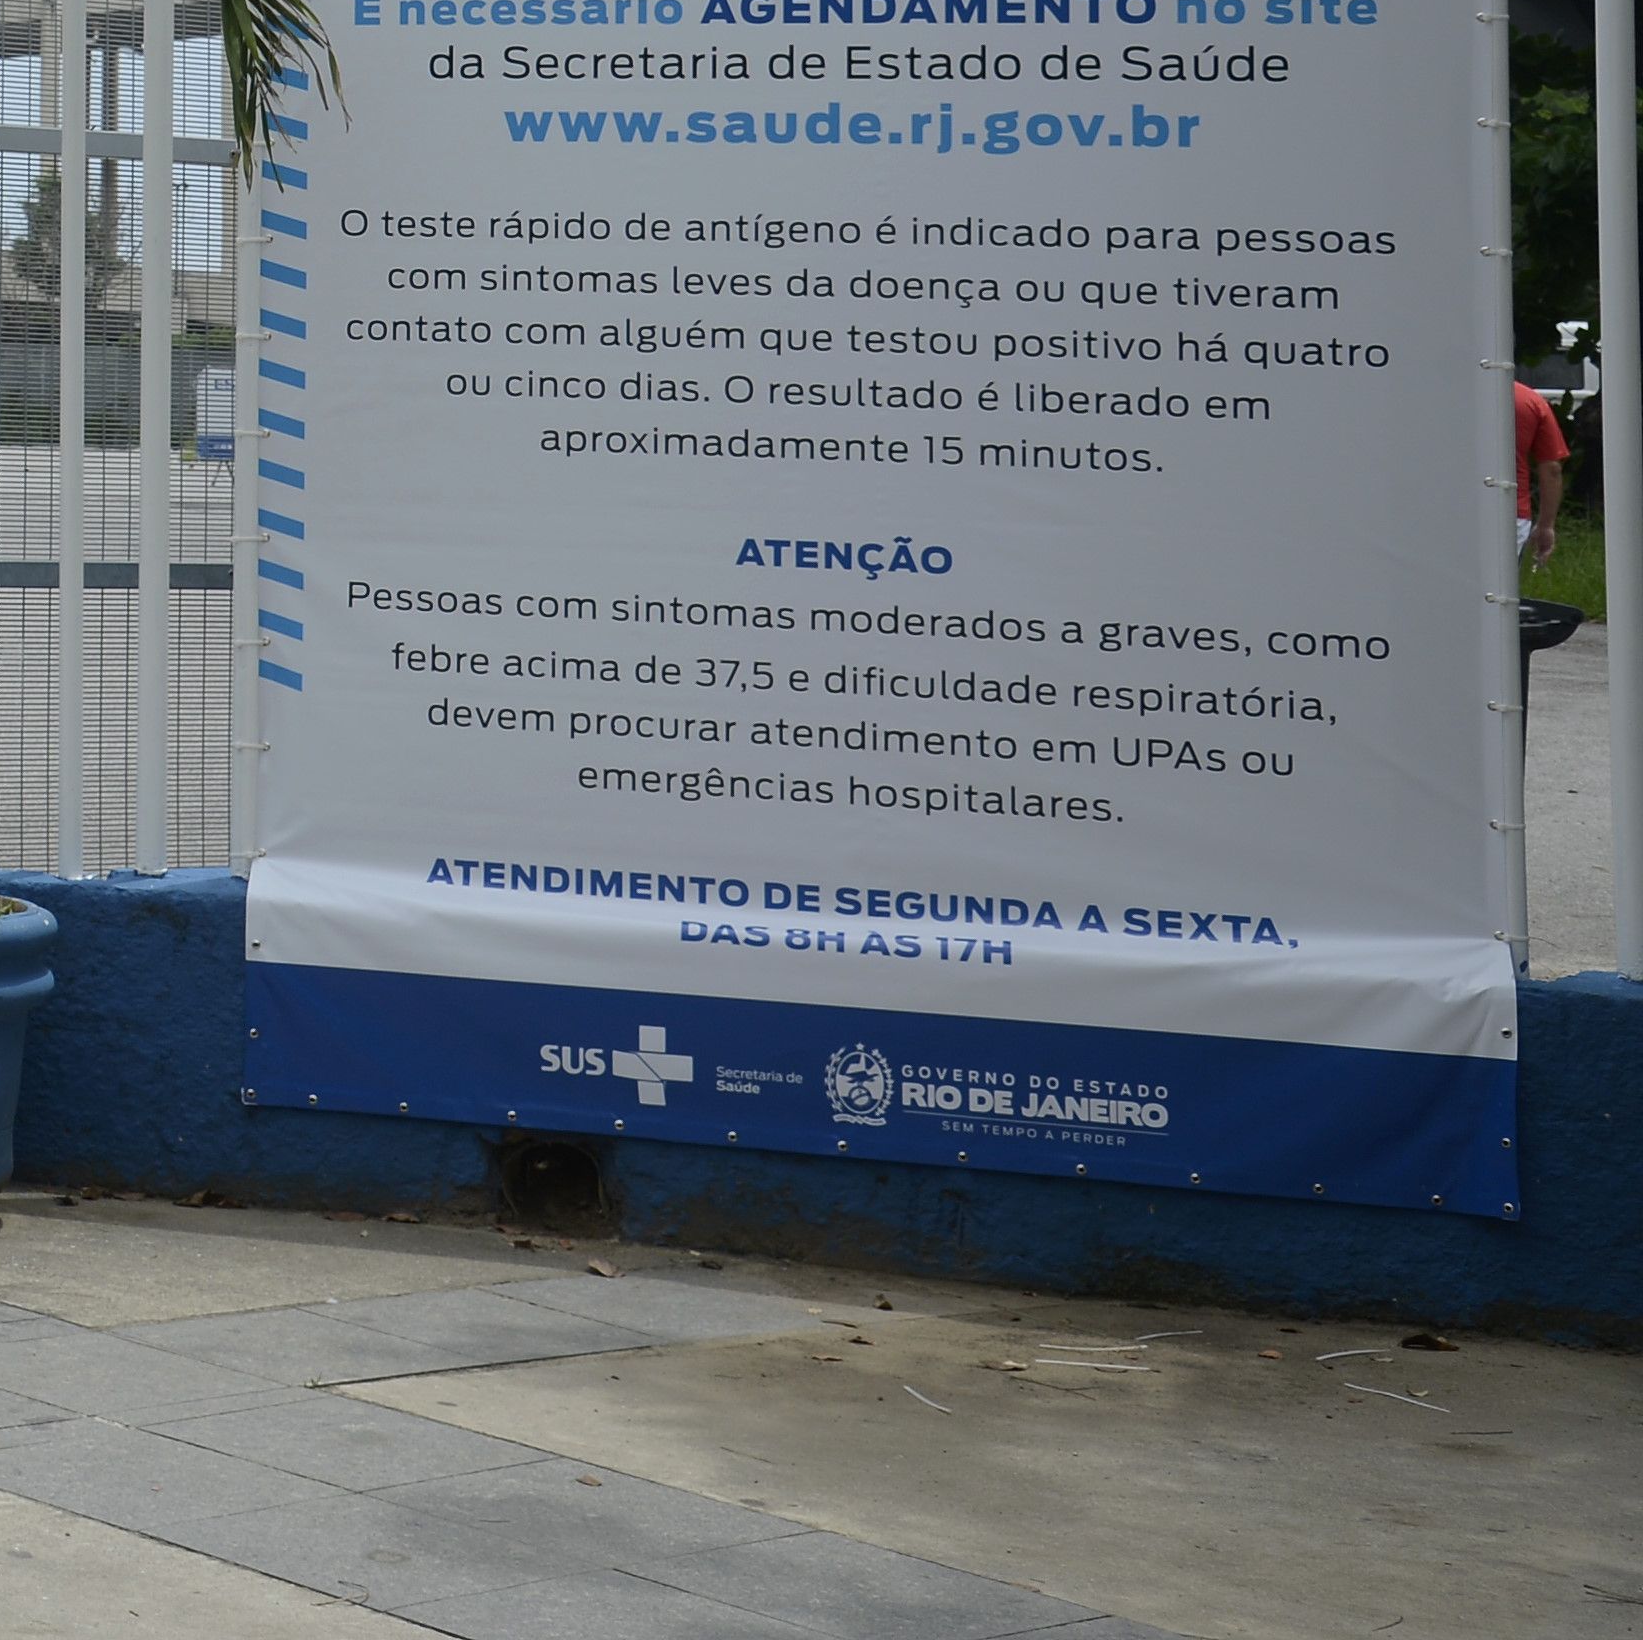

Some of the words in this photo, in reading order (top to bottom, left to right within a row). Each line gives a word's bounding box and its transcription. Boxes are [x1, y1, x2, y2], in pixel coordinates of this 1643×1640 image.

[430, 45, 484, 79] da
[503, 46, 749, 79] Secretaria
[769, 45, 825, 79] de
[847, 45, 1020, 80] Estado
[1041, 45, 1100, 80] de
[1122, 45, 1288, 82] Saúde
[504, 102, 1199, 155] www.saude.rj.gov.br
[341, 210, 367, 236] O
[381, 211, 475, 237] teste
[491, 211, 610, 244] rápido
[625, 213, 670, 240] de
[685, 214, 860, 248] antígeno
[876, 216, 896, 244] é
[913, 217, 1089, 247] indicado
[1107, 227, 1200, 254] para
[1218, 229, 1395, 256] pessoas
[389, 269, 465, 289] com
[481, 264, 657, 293] sintomas
[674, 266, 771, 295] leves
[787, 269, 834, 297] da
[850, 270, 1000, 308] doença
[1017, 280, 1064, 302] ou
[1081, 282, 1157, 309] que
[1173, 278, 1338, 309] tiveram
[347, 316, 491, 343] contato
[506, 323, 584, 345] com
[600, 319, 744, 353] alguém
[761, 329, 832, 355] que
[847, 326, 976, 355] testou
[995, 330, 1161, 361] positivo
[1179, 332, 1228, 362] há
[1245, 338, 1389, 369] quatro
[447, 375, 490, 395] ou
[506, 370, 605, 399] cinco
[621, 372, 709, 401] dias.
[725, 376, 753, 403] O
[770, 378, 962, 409] resultado
[978, 382, 998, 410] é
[1016, 383, 1189, 417] liberado
[1206, 397, 1269, 419] em
[541, 427, 908, 462] aproximadamente
[924, 436, 963, 464] 15
[980, 440, 1162, 472] minutos.
[736, 536, 952, 580] ATENÇÃO
[349, 582, 502, 615] Pessoas
[517, 596, 596, 619] com
[612, 595, 794, 629] sintomas
[811, 606, 1045, 641] moderados
[1061, 622, 1083, 643] a
[1100, 623, 1250, 656] graves,
[1268, 632, 1389, 659] como
[392, 642, 488, 674] febre
[504, 651, 620, 681] acima
[635, 655, 680, 685] de
[696, 659, 773, 692] 37,5
[789, 670, 809, 691] e
[825, 665, 1056, 705] dificuldade
[1074, 684, 1335, 725] respiratória,
[428, 698, 554, 731] devem
[571, 713, 736, 742] procurar
[751, 719, 1016, 759] atendimento
[1033, 739, 1095, 763] em
[1114, 737, 1226, 771] UPAs
[1243, 752, 1292, 775] ou
[579, 767, 833, 803] emergências
[850, 776, 1122, 822] hospitalares.
[427, 858, 749, 907] ATENDIMENTO
[764, 882, 820, 912] DE
[835, 887, 1062, 928] SEGUNDA
[1079, 905, 1107, 932] A
[1124, 908, 1297, 948] SEXTA,
[679, 920, 769, 947] DAS
[785, 929, 846, 953] 8H
[937, 938, 1012, 965] 17H
[540, 1045, 605, 1075] SUS
[716, 1066, 783, 1084] Secretaria
[786, 1072, 803, 1083] de
[902, 1065, 1015, 1086] GOVERNO
[1030, 1075, 1059, 1089] DO
[1074, 1079, 1168, 1099] ESTADO
[716, 1080, 760, 1094] Saúde
[902, 1082, 962, 1110] RIO
[969, 1088, 1014, 1115] DE
[1021, 1093, 1168, 1127] JANEIRO
[942, 1121, 973, 1132] SEM
[982, 1124, 1037, 1138] TEMPO
[1045, 1130, 1054, 1139] A
[1062, 1131, 1125, 1146] PERDER
